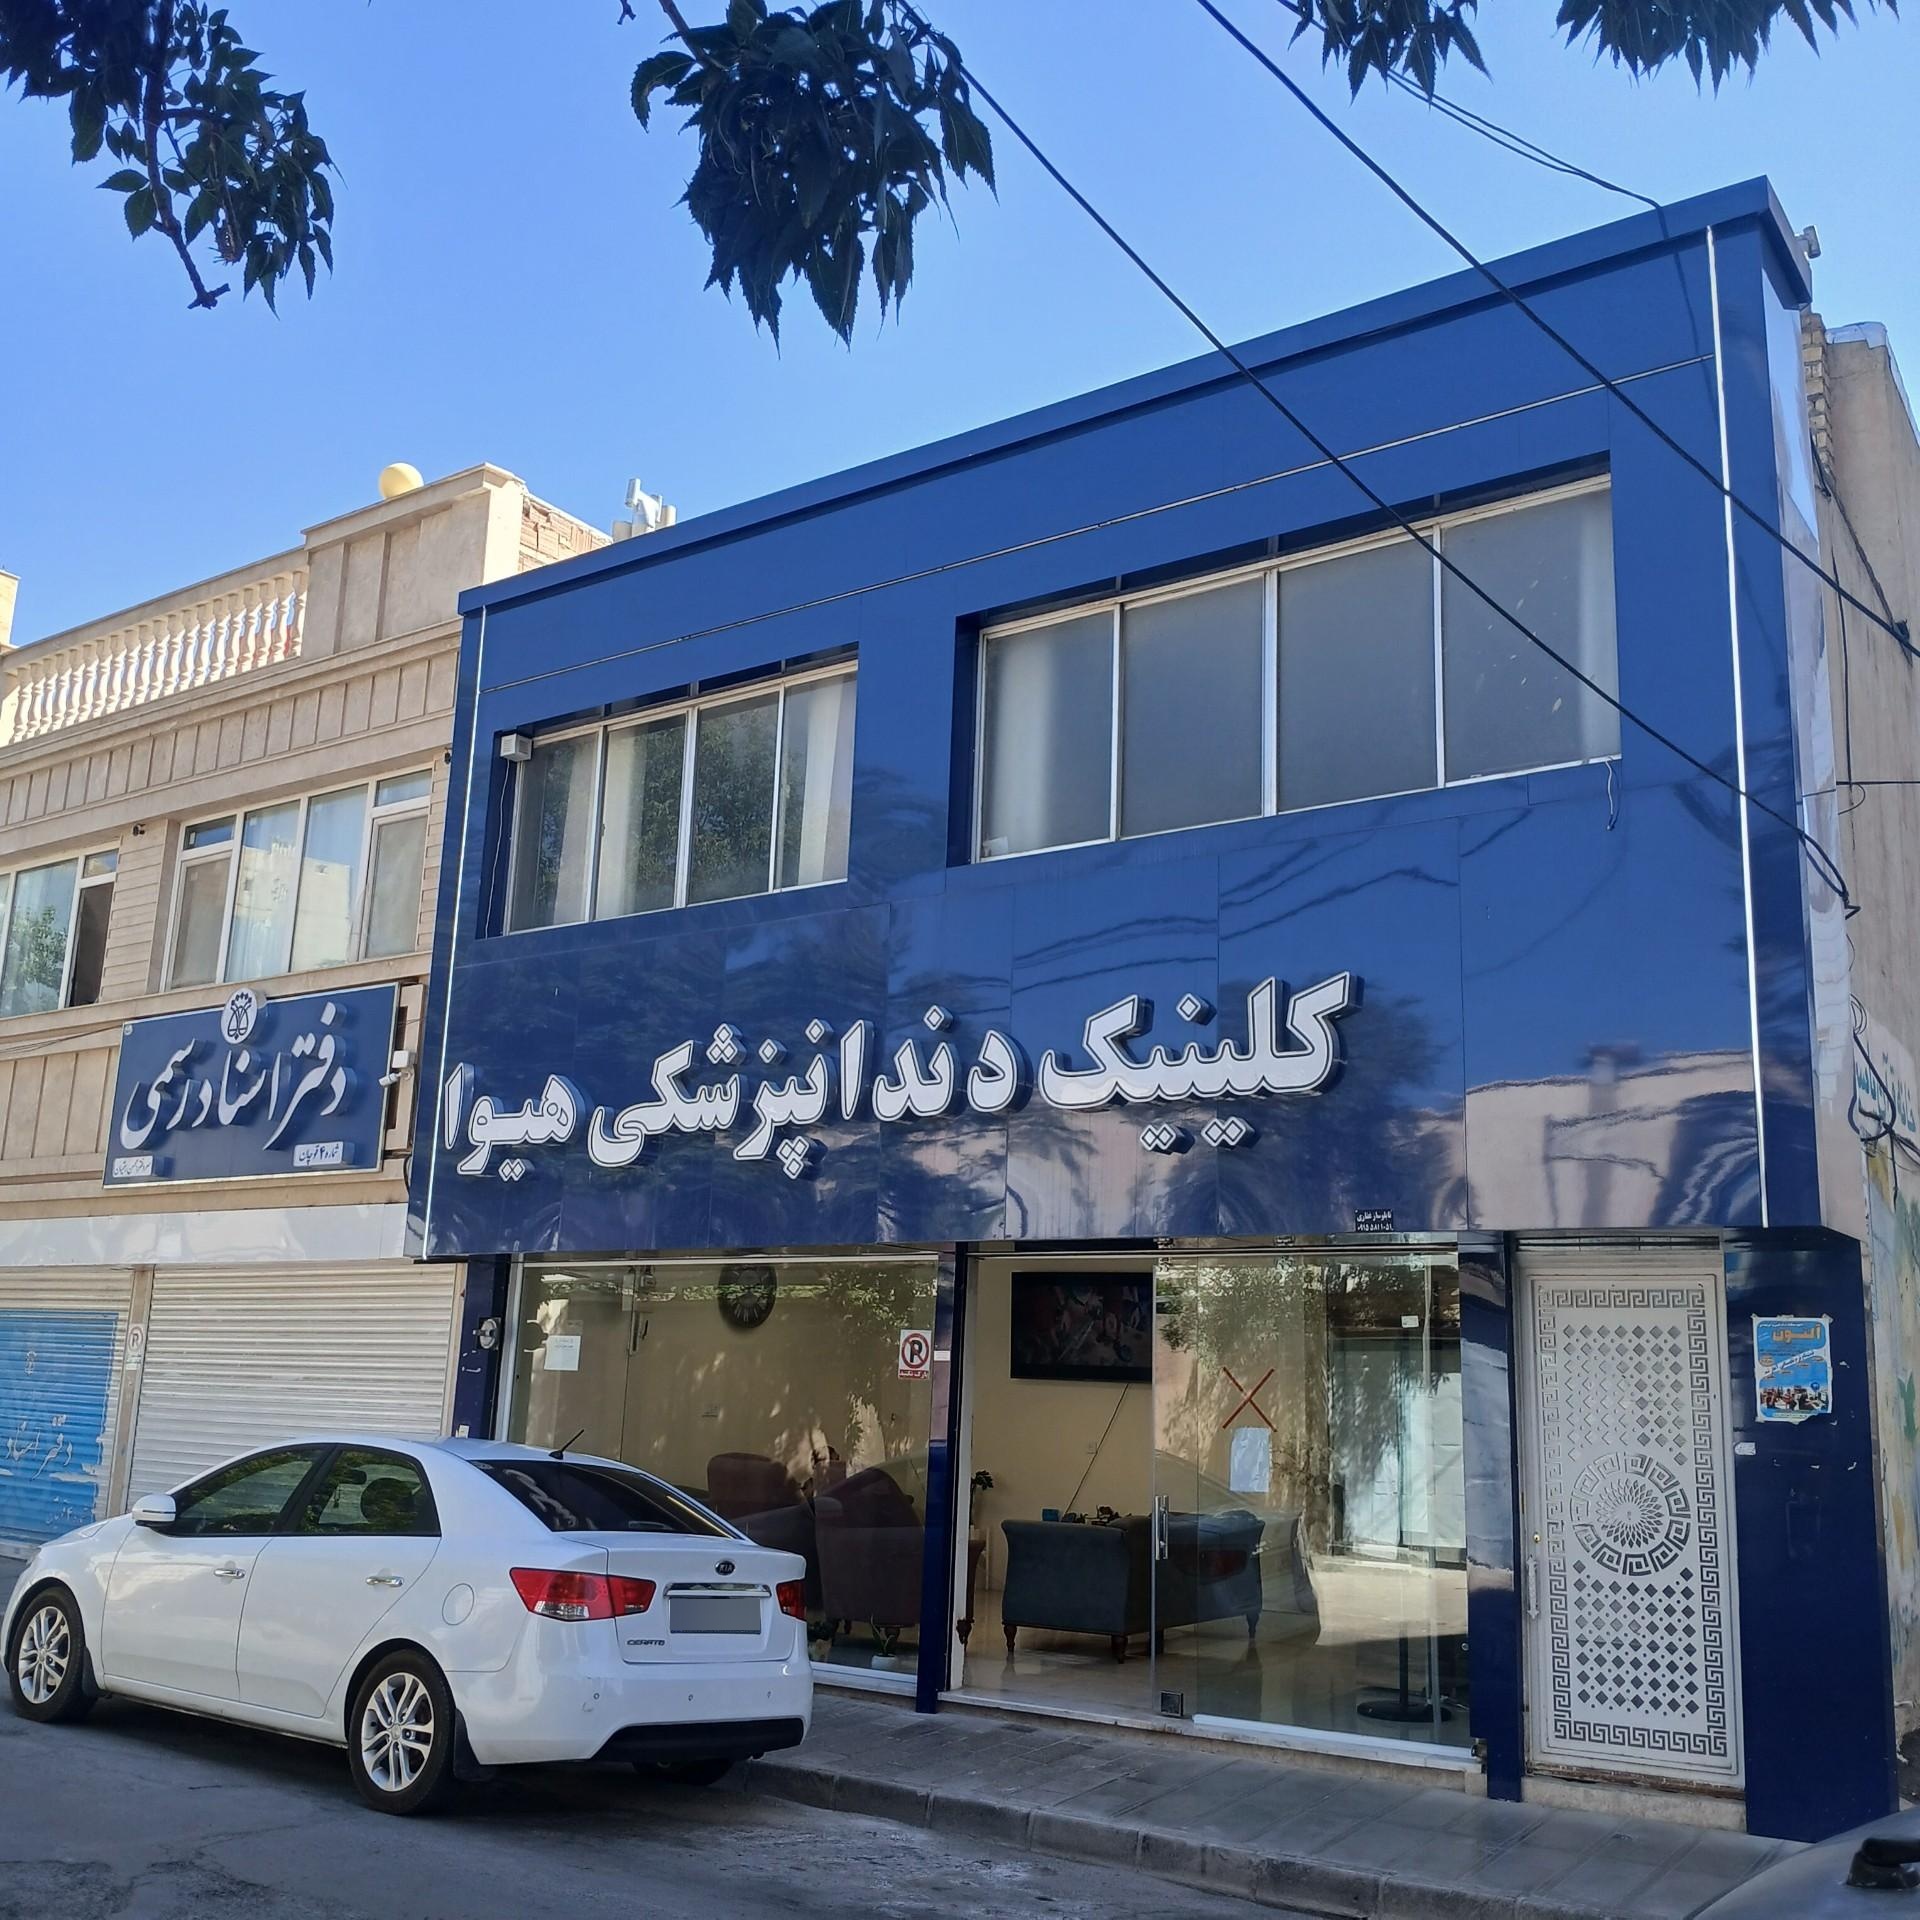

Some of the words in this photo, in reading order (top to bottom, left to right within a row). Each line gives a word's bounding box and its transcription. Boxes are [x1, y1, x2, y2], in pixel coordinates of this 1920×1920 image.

[120, 1038, 196, 1150] رسمی
[192, 1049, 281, 1128] اسناد
[263, 1001, 347, 1150] دفتر
[588, 1005, 1020, 1181] دندانپزشکی
[1038, 971, 1353, 1154] کلینیک
[299, 1144, 319, 1166] قوچان
[320, 1146, 325, 1159] ۴
[325, 1143, 339, 1159] شماره
[444, 1062, 578, 1183] هیوا
[32, 1414, 73, 1480] دفتر
[719, 1564, 733, 1572] KIA
